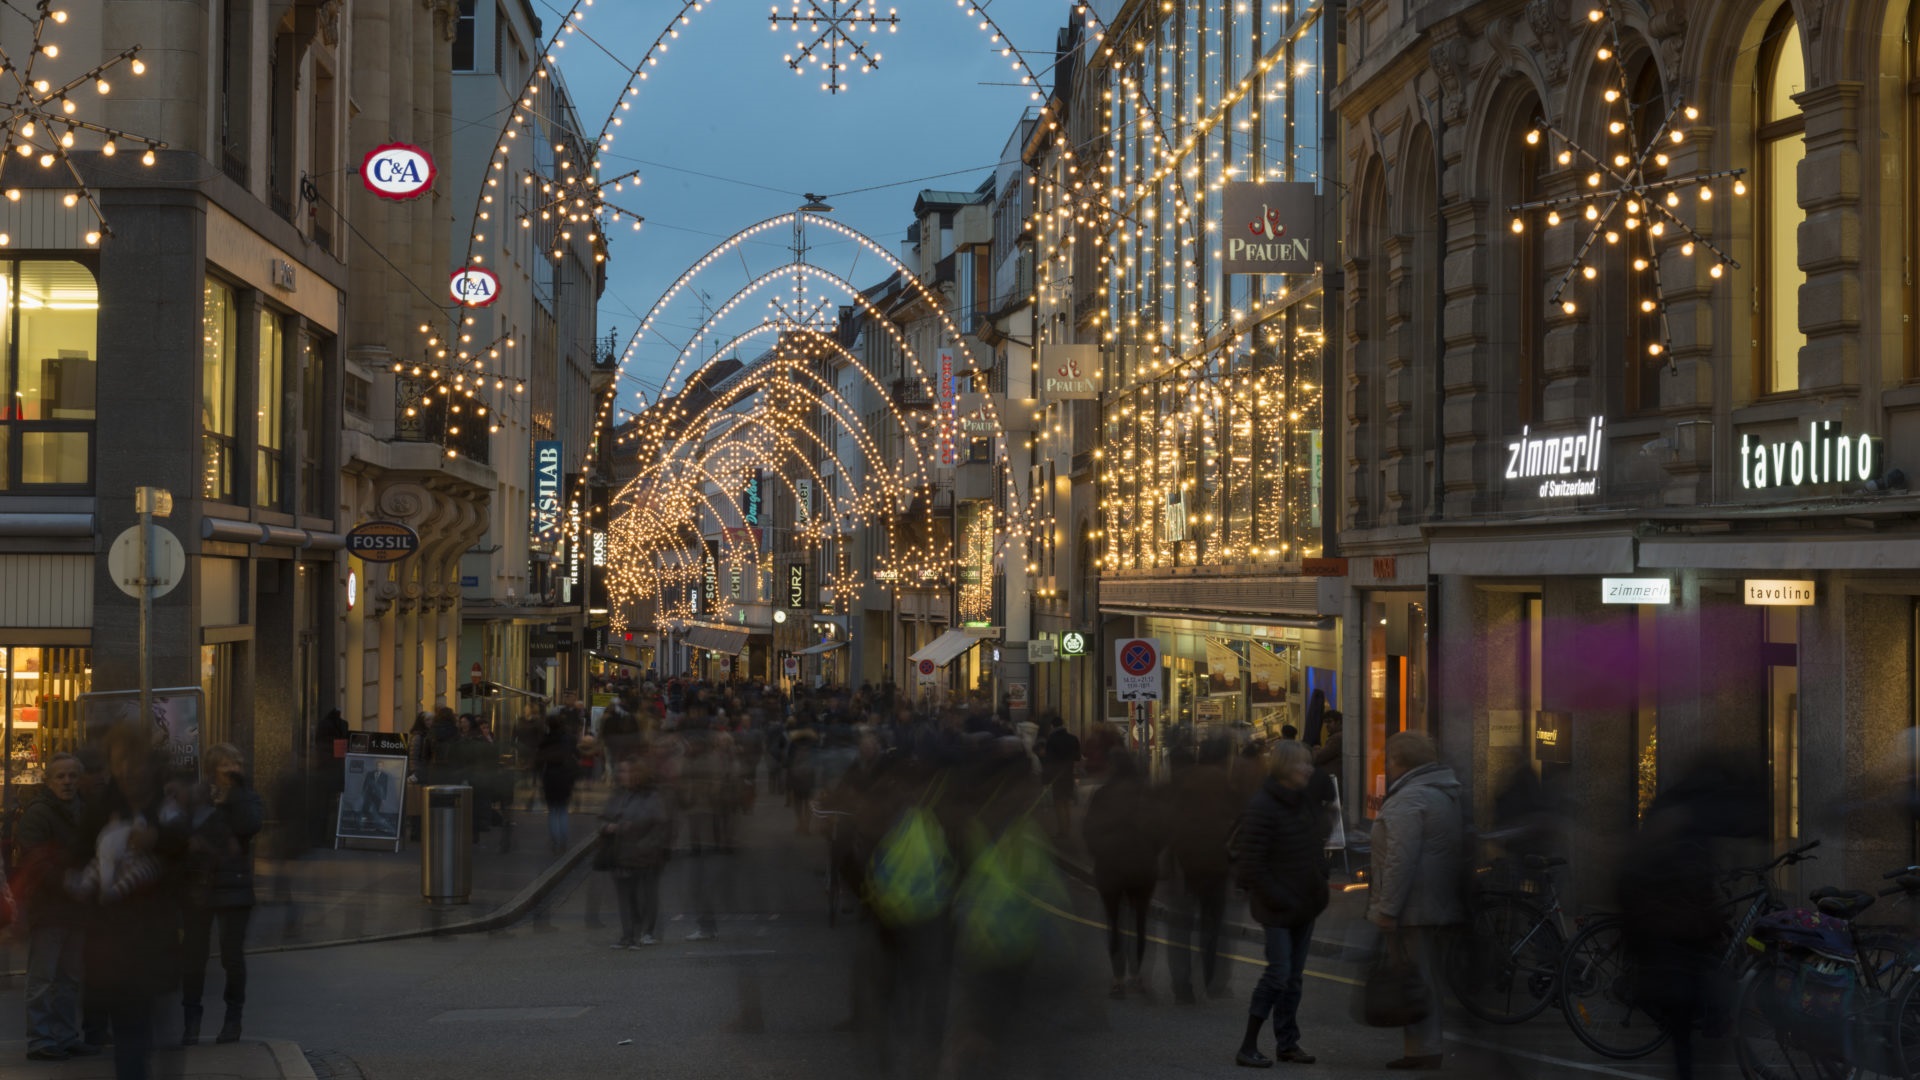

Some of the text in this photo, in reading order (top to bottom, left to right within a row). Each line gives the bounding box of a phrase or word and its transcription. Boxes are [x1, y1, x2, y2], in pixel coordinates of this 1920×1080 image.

[374, 158, 423, 183] C&A
[1228, 238, 1310, 261] PFAUEN
[456, 277, 491, 296] C&A
[941, 354, 952, 398] SPORT
[1046, 378, 1095, 392] PFAUEN
[1505, 415, 1603, 479] zimmerli
[1741, 420, 1872, 489] tavolino
[539, 448, 558, 532] VISILAB
[1539, 477, 1596, 497] of Switzerland
[353, 536, 411, 548] FOSSIL
[593, 532, 604, 566] BOSS
[792, 566, 802, 607] KURZ
[1610, 584, 1668, 597] zimmerli
[1750, 586, 1810, 600] tavolino
[380, 740, 404, 749] Stock
